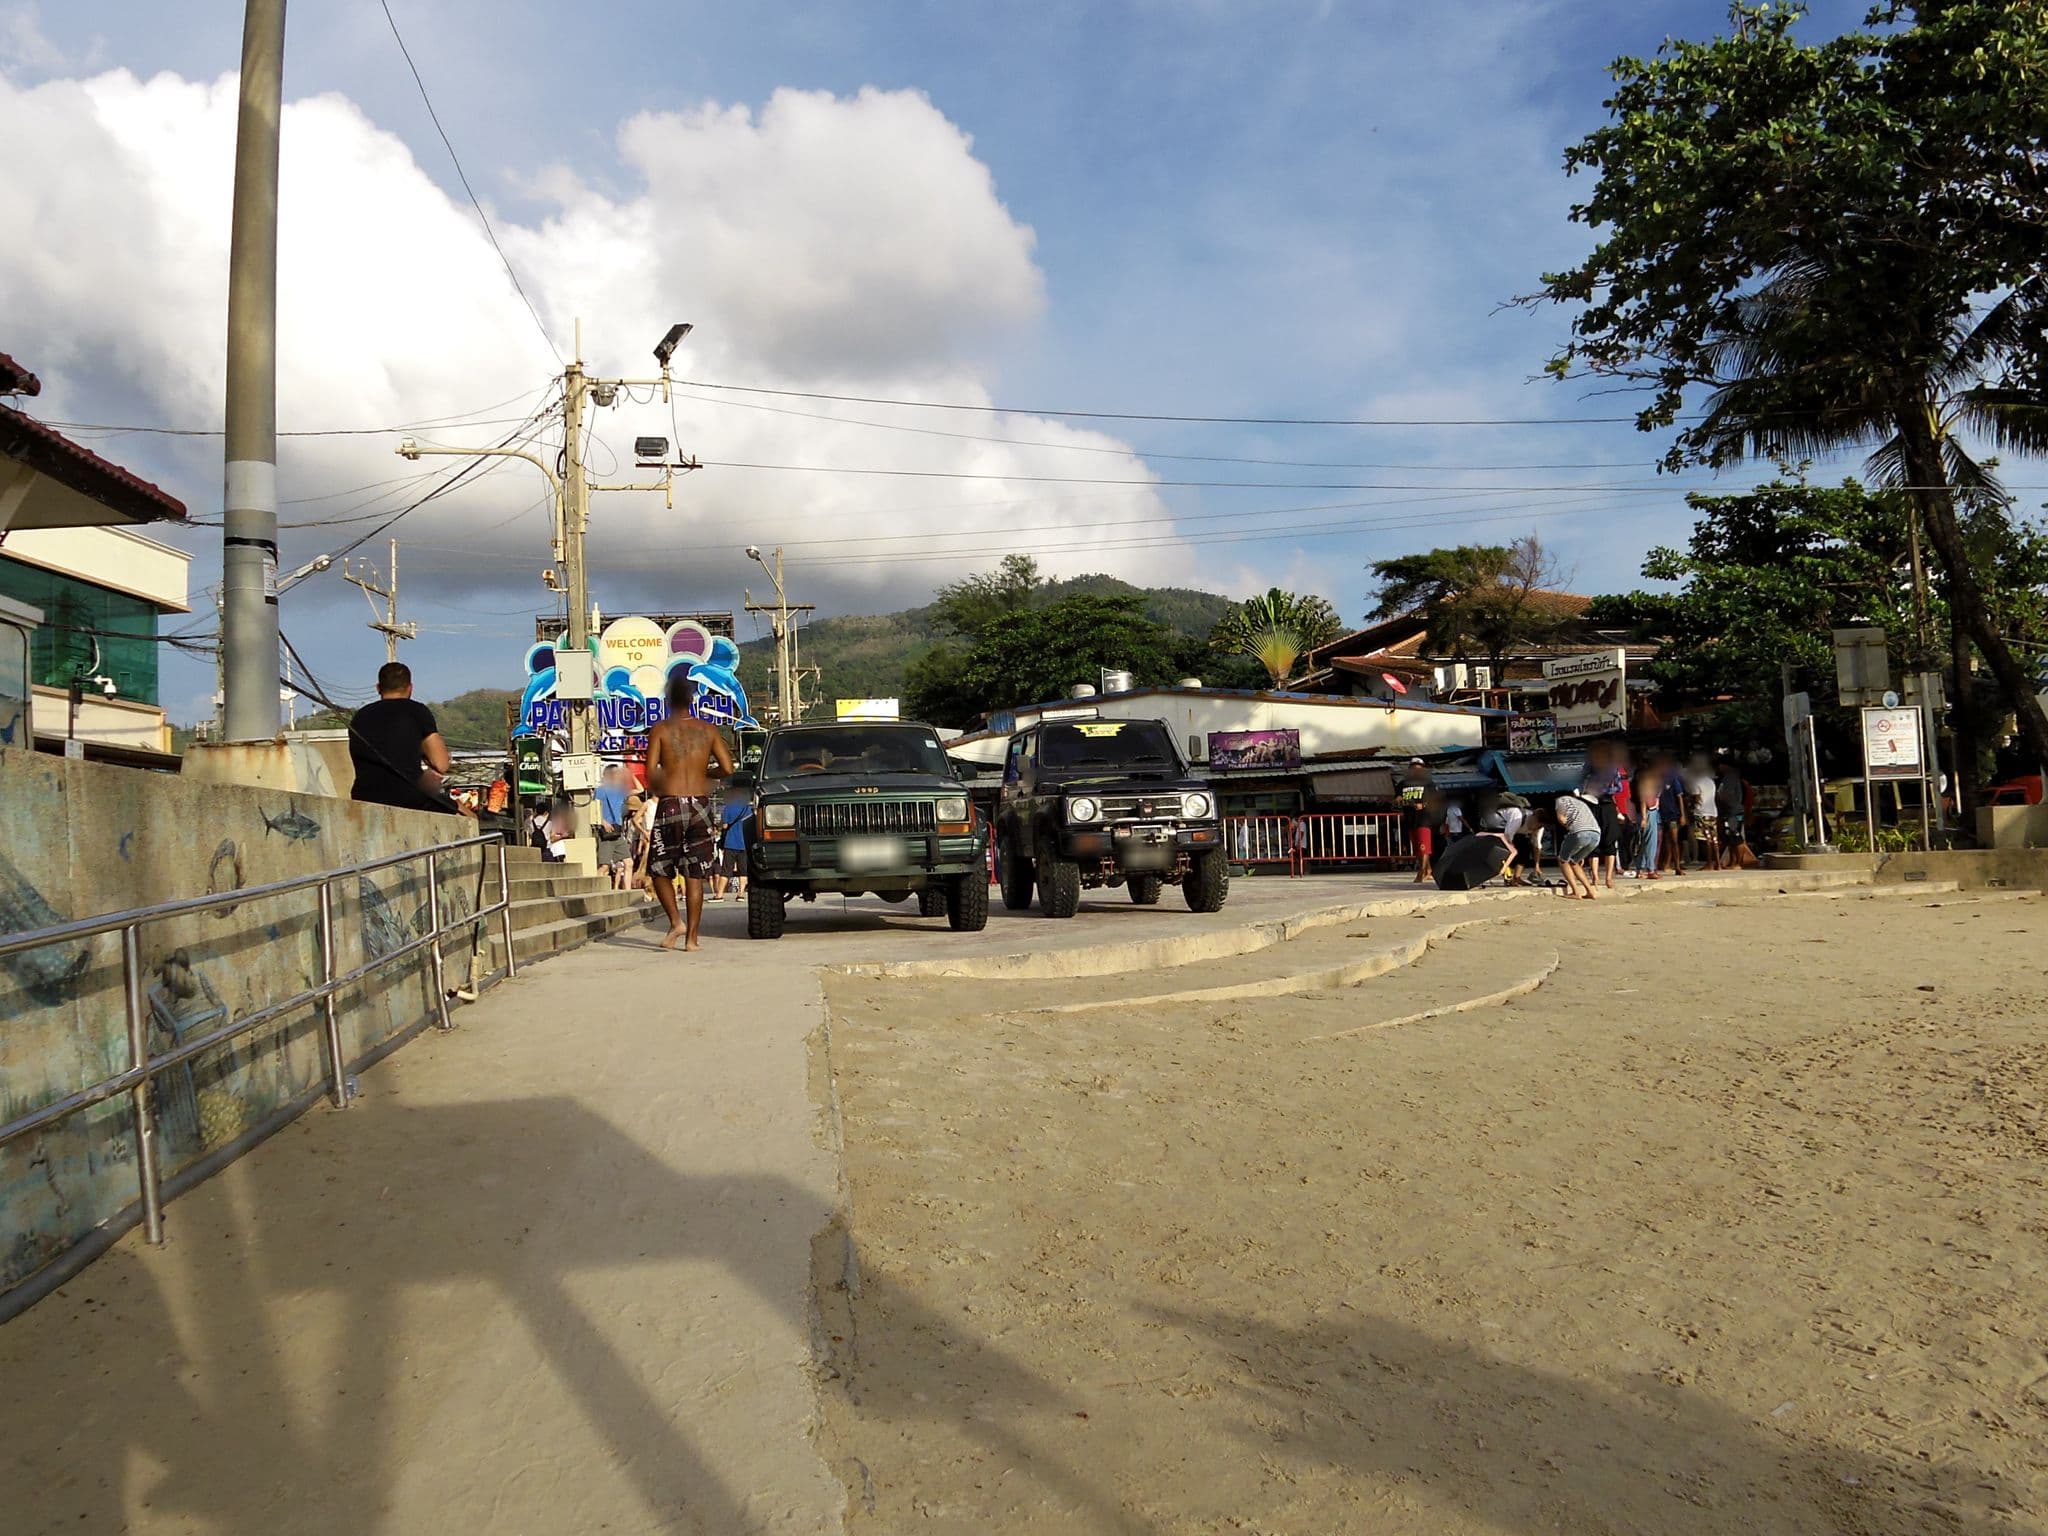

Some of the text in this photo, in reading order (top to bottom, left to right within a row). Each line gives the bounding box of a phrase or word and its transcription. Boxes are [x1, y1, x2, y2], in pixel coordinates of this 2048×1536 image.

[606, 638, 662, 648] WELCOME
[627, 652, 643, 661] TO
[531, 695, 734, 732] PANG BCH
